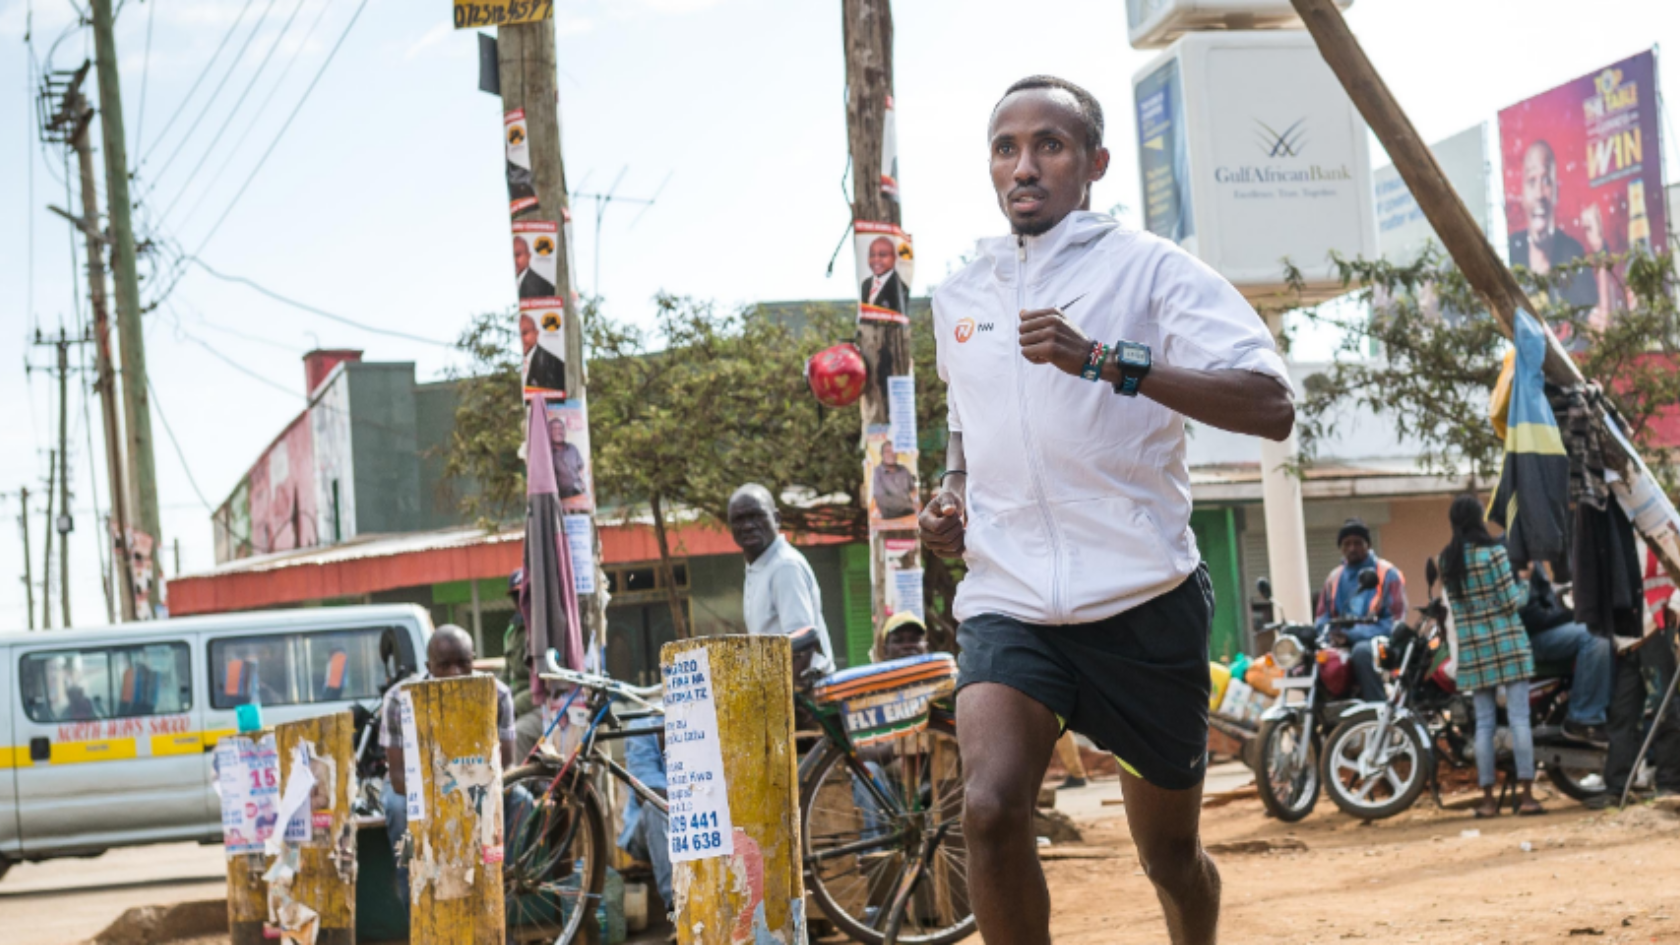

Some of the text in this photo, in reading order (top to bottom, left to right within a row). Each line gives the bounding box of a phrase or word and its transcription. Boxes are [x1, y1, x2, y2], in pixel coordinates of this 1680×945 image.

[1587, 127, 1643, 181] WIN
[847, 706, 878, 732] FLY
[250, 767, 276, 789] 15
[690, 811, 718, 830] 441
[692, 830, 722, 851] 638
